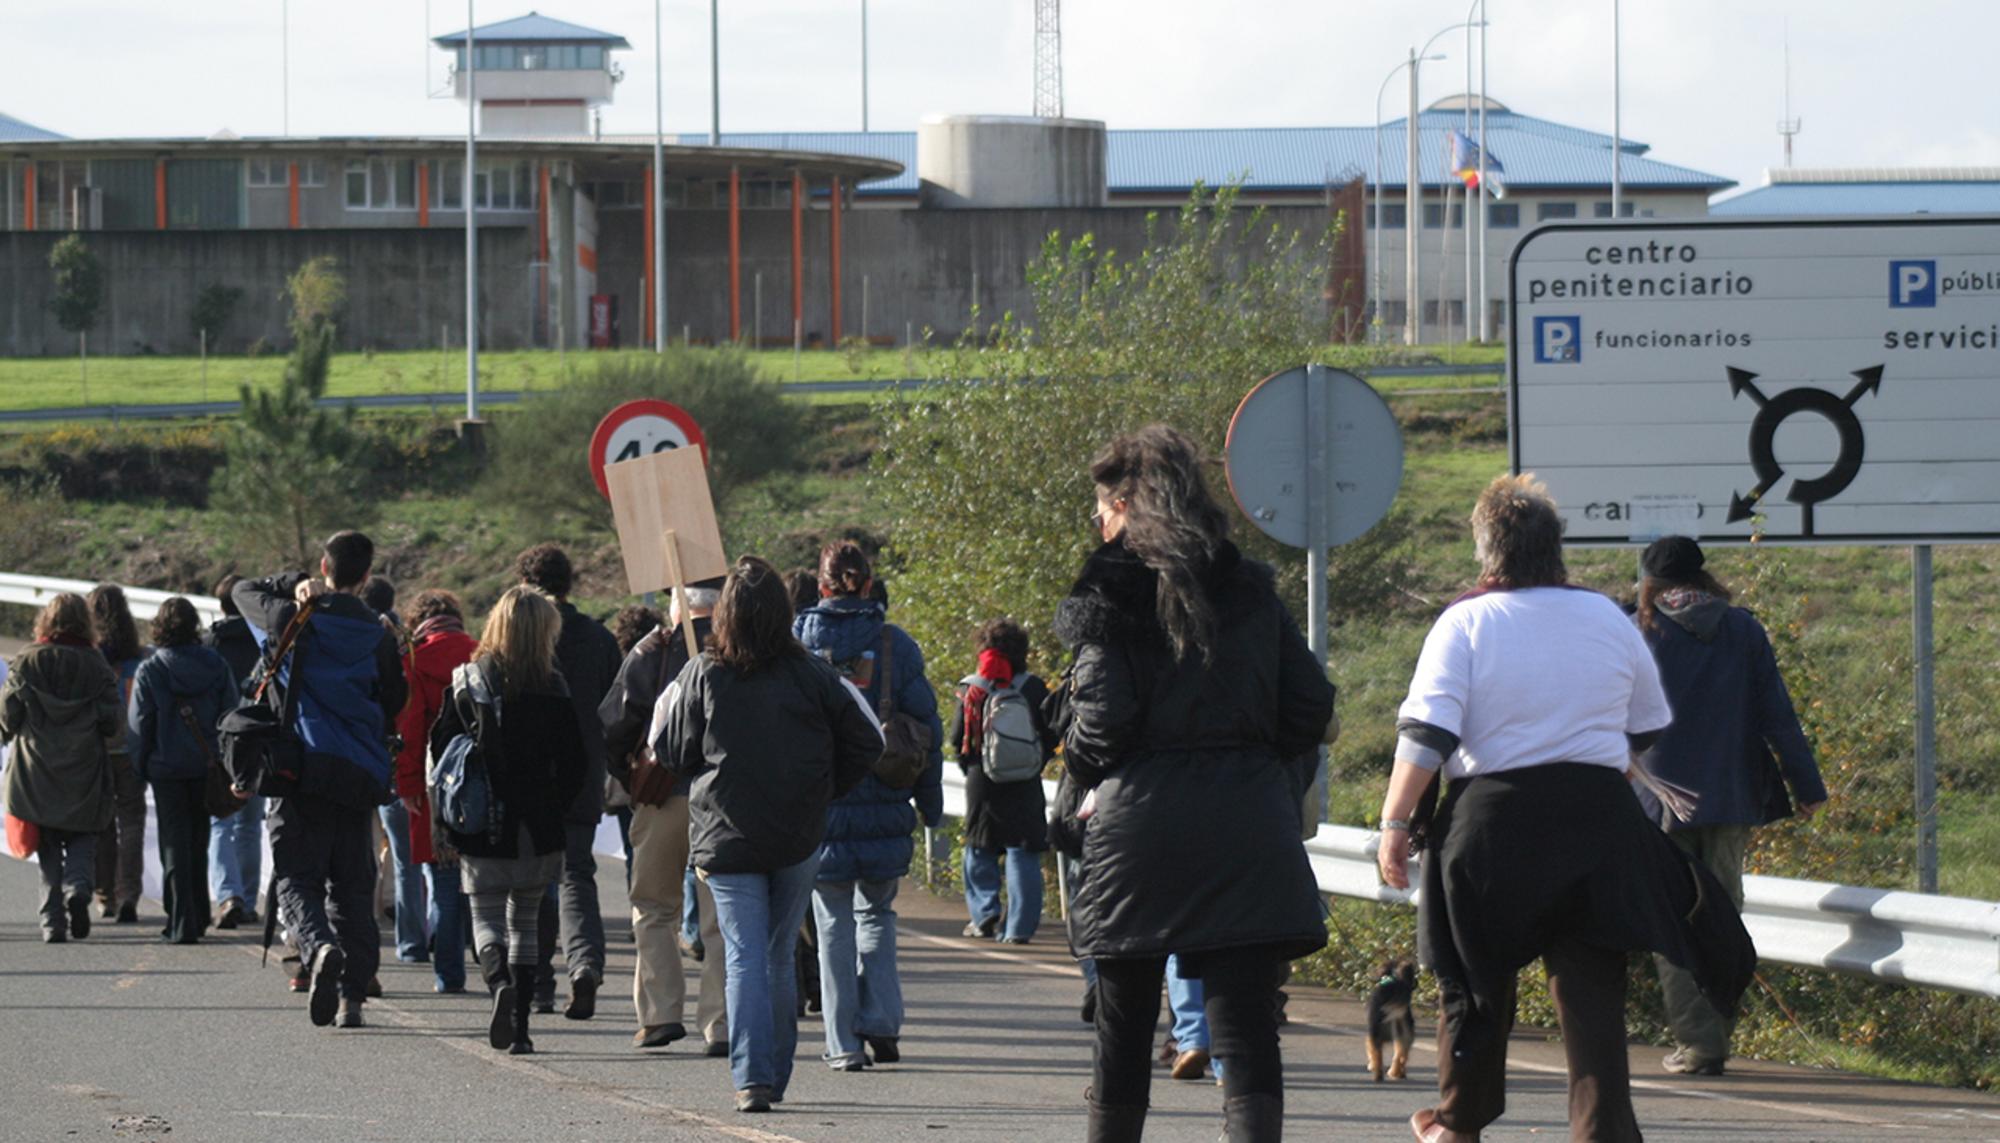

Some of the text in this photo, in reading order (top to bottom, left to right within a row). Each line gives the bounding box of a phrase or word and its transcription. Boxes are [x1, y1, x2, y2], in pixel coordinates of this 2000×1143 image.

[1585, 240, 1697, 265] centro
[1529, 270, 1753, 304] penitenciario
[1899, 266, 1929, 303] P
[1543, 322, 1751, 360] P funcionarios
[1884, 324, 1997, 349] servici
